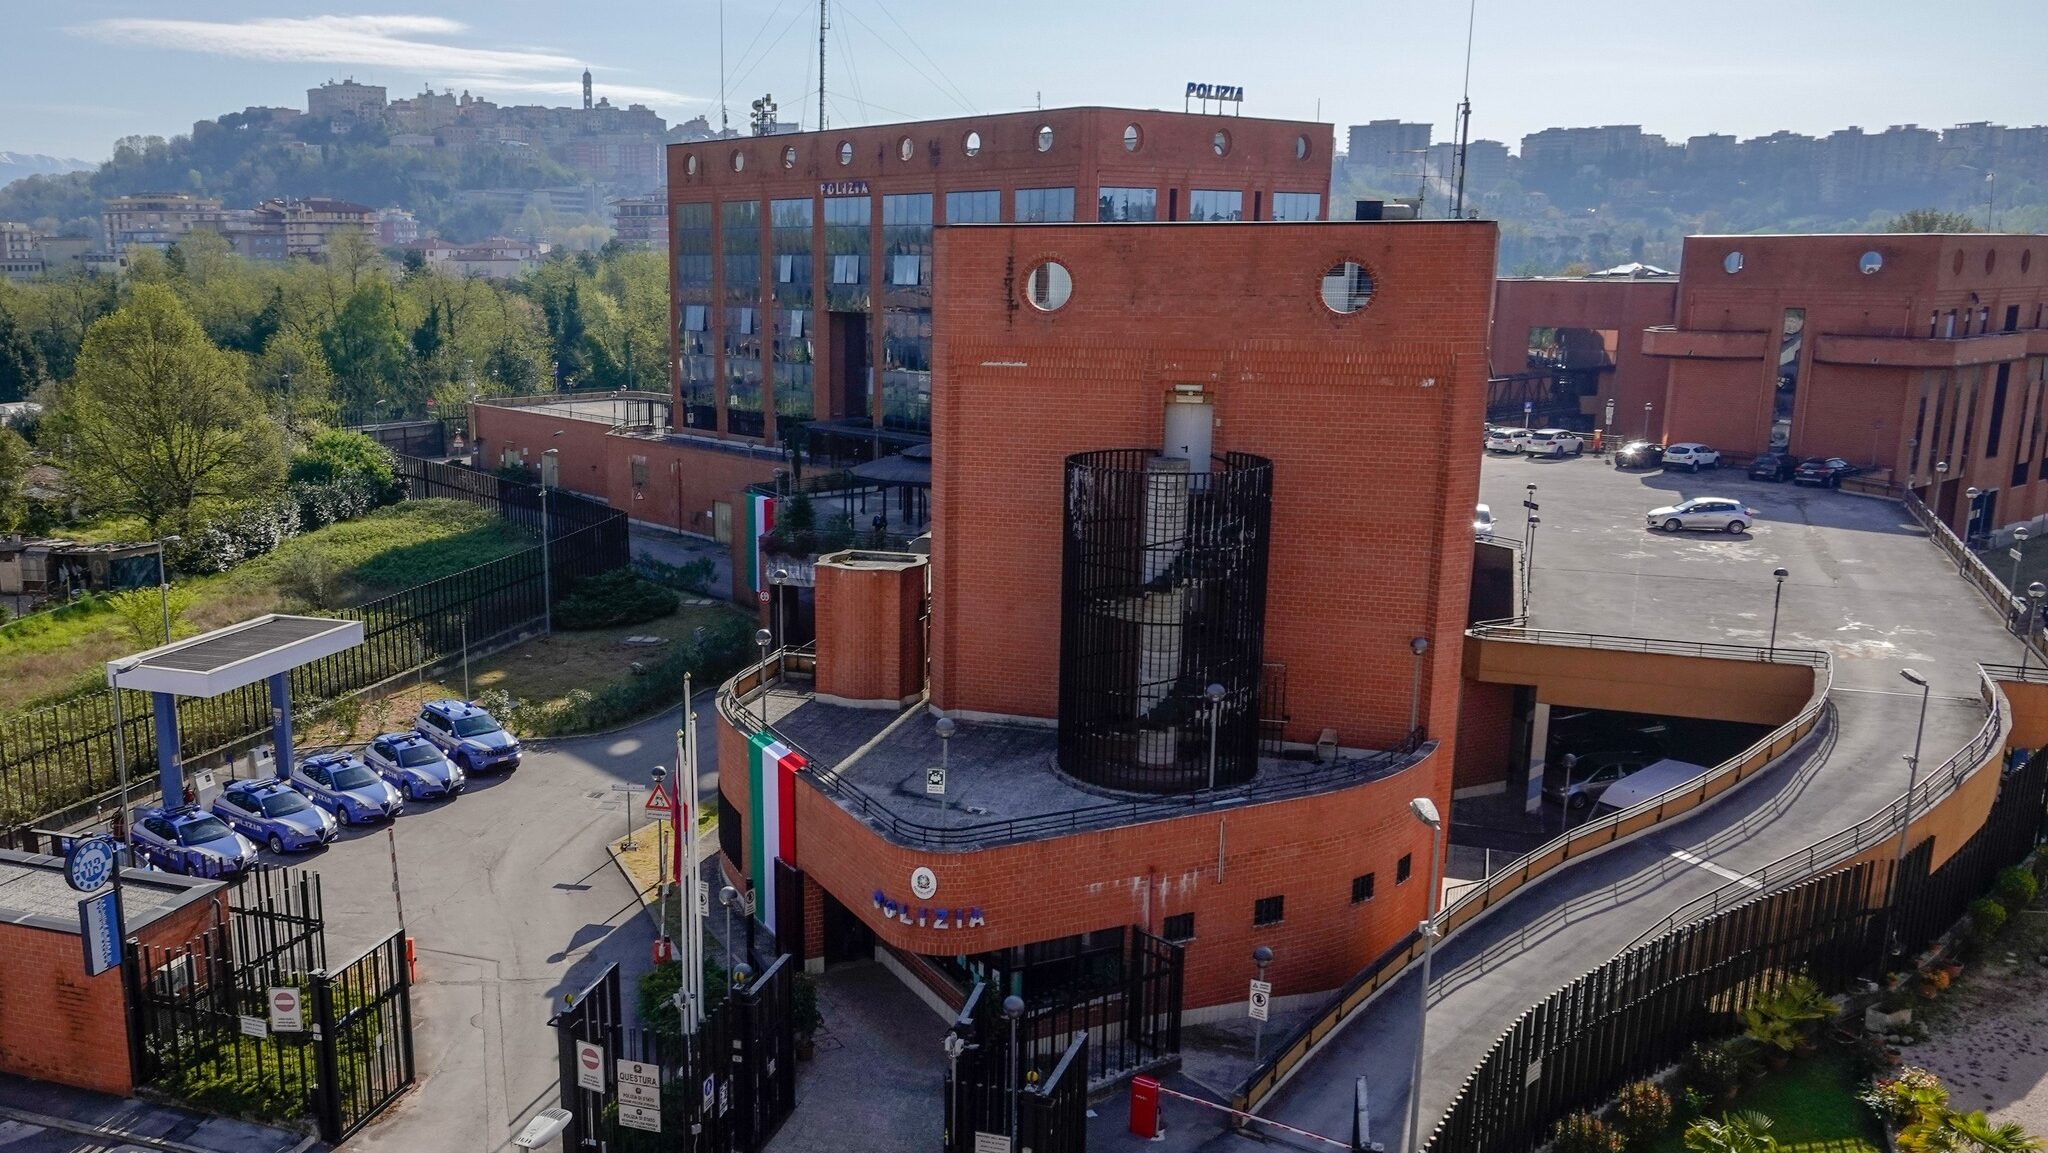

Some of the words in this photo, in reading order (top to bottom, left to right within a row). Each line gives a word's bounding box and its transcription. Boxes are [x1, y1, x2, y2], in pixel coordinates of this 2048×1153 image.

[1186, 82, 1243, 102] POLIZIA
[820, 181, 870, 196] POLIZIA
[228, 815, 263, 832] POLIZIA
[83, 857, 102, 880] 113
[872, 889, 985, 929] POLIZIA
[619, 1072, 658, 1086] QUESTURA
